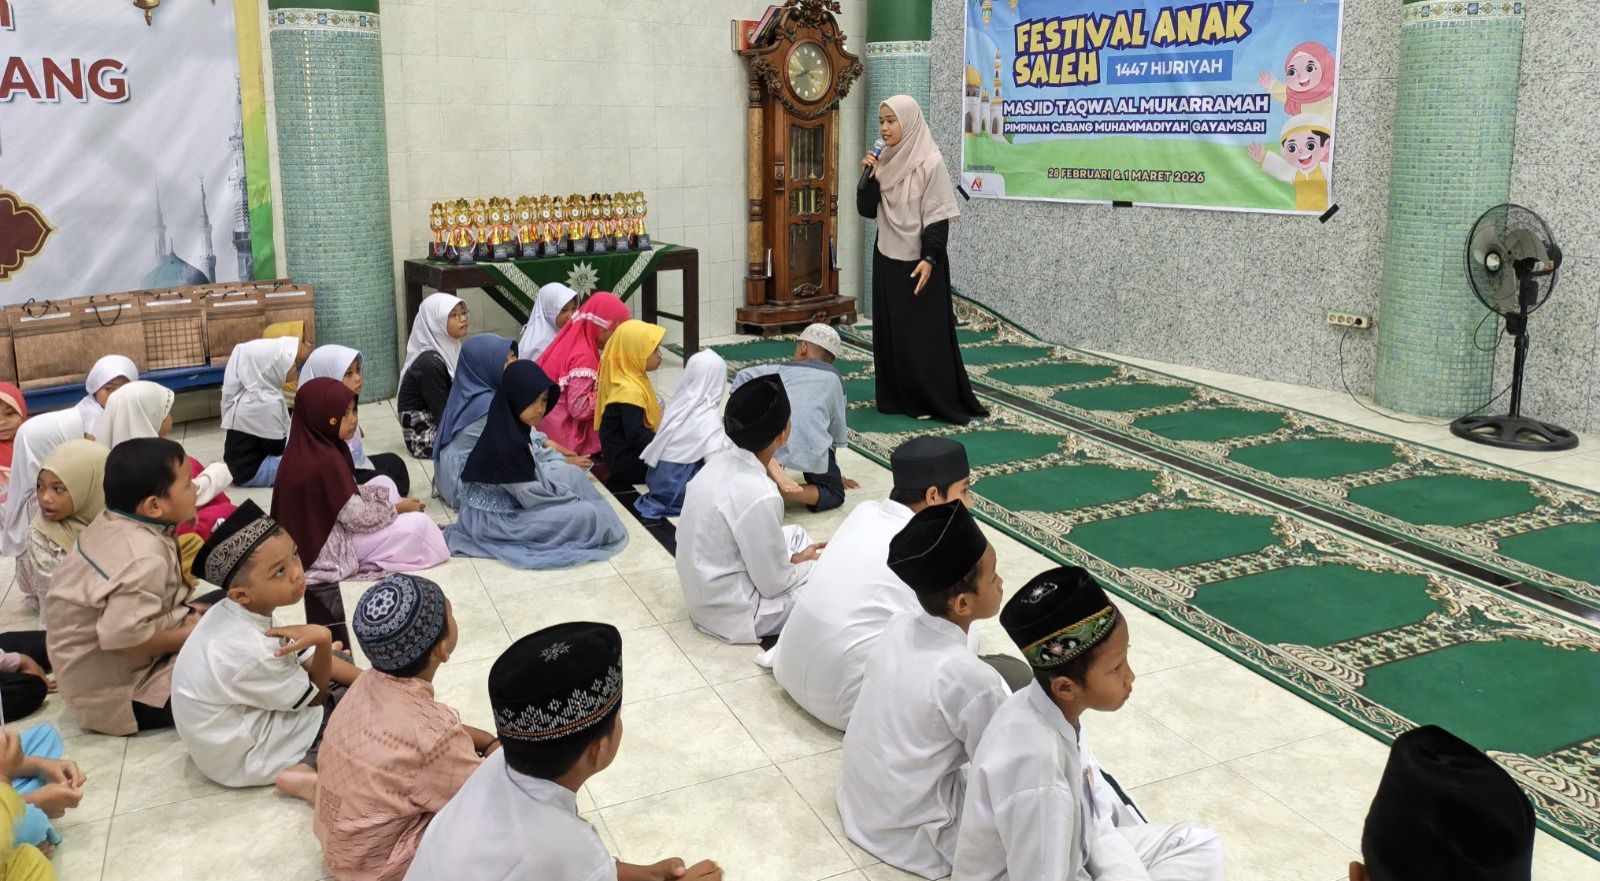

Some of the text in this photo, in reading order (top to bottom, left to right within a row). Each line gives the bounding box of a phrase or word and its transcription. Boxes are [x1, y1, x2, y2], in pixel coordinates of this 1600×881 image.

[1015, 3, 1252, 54] FESTIVAL ANAK
[0, 56, 128, 101] ANG
[1014, 50, 1099, 86] SALEH
[1115, 58, 1223, 77] 1447 HIJRIYAH
[1003, 94, 1269, 118] MASJID TAQWA AL MUKARRAMAH
[1004, 120, 1265, 133] PIMPINAN CABANG MUHAMMADIYAH GAYAMSARI
[1048, 168, 1205, 183] 28 FEBRUARI & 1 MARET 2026
